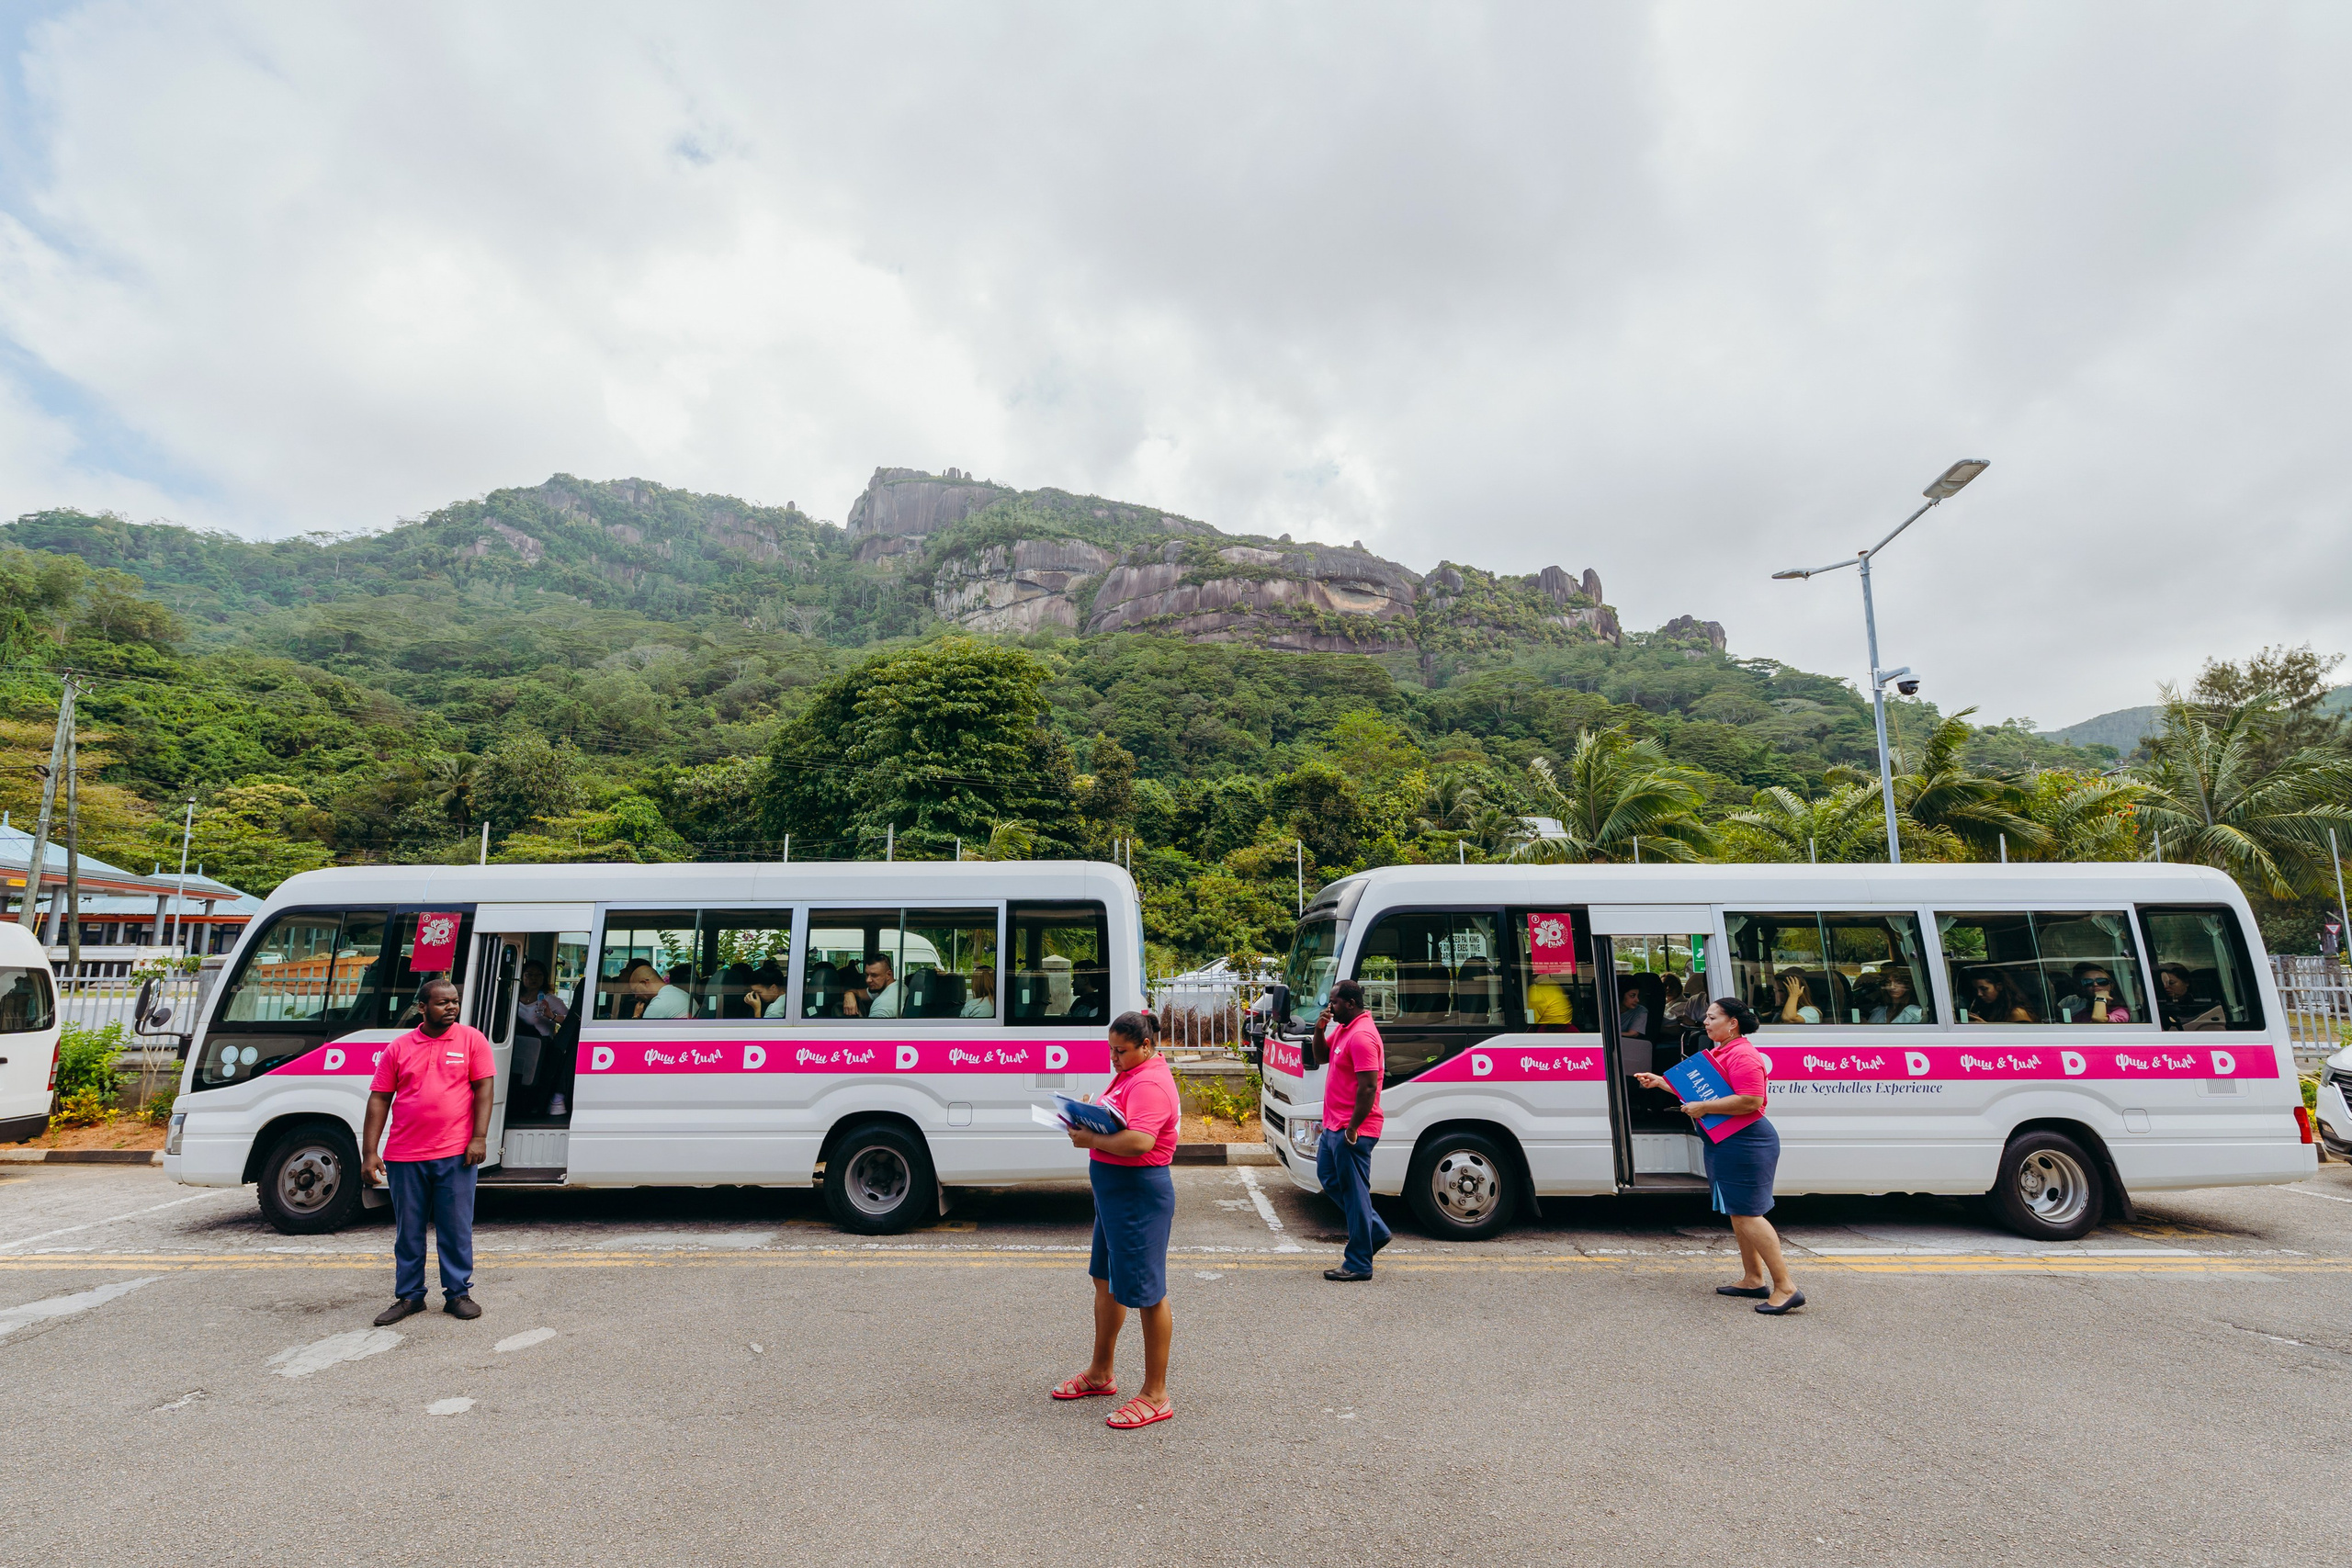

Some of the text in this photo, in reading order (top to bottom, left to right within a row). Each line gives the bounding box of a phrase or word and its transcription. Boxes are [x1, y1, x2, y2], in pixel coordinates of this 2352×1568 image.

[1457, 943, 1481, 952] EXECTIVE
[1461, 935, 1480, 943] PAKING
[644, 1048, 723, 1066] Фиш & Чилл
[796, 1047, 876, 1066] Фиш & Чилл
[948, 1047, 1029, 1066] Фиш & Чилл
[1520, 1055, 1594, 1073] Фиш & Чилл
[1803, 1054, 1885, 1073] Фиш & Чилл
[1960, 1054, 2042, 1073] Фиш & Чилл
[2115, 1053, 2197, 1072] Фиш & Чилл
[1768, 1081, 1943, 1096] ive the Seychelles Experience
